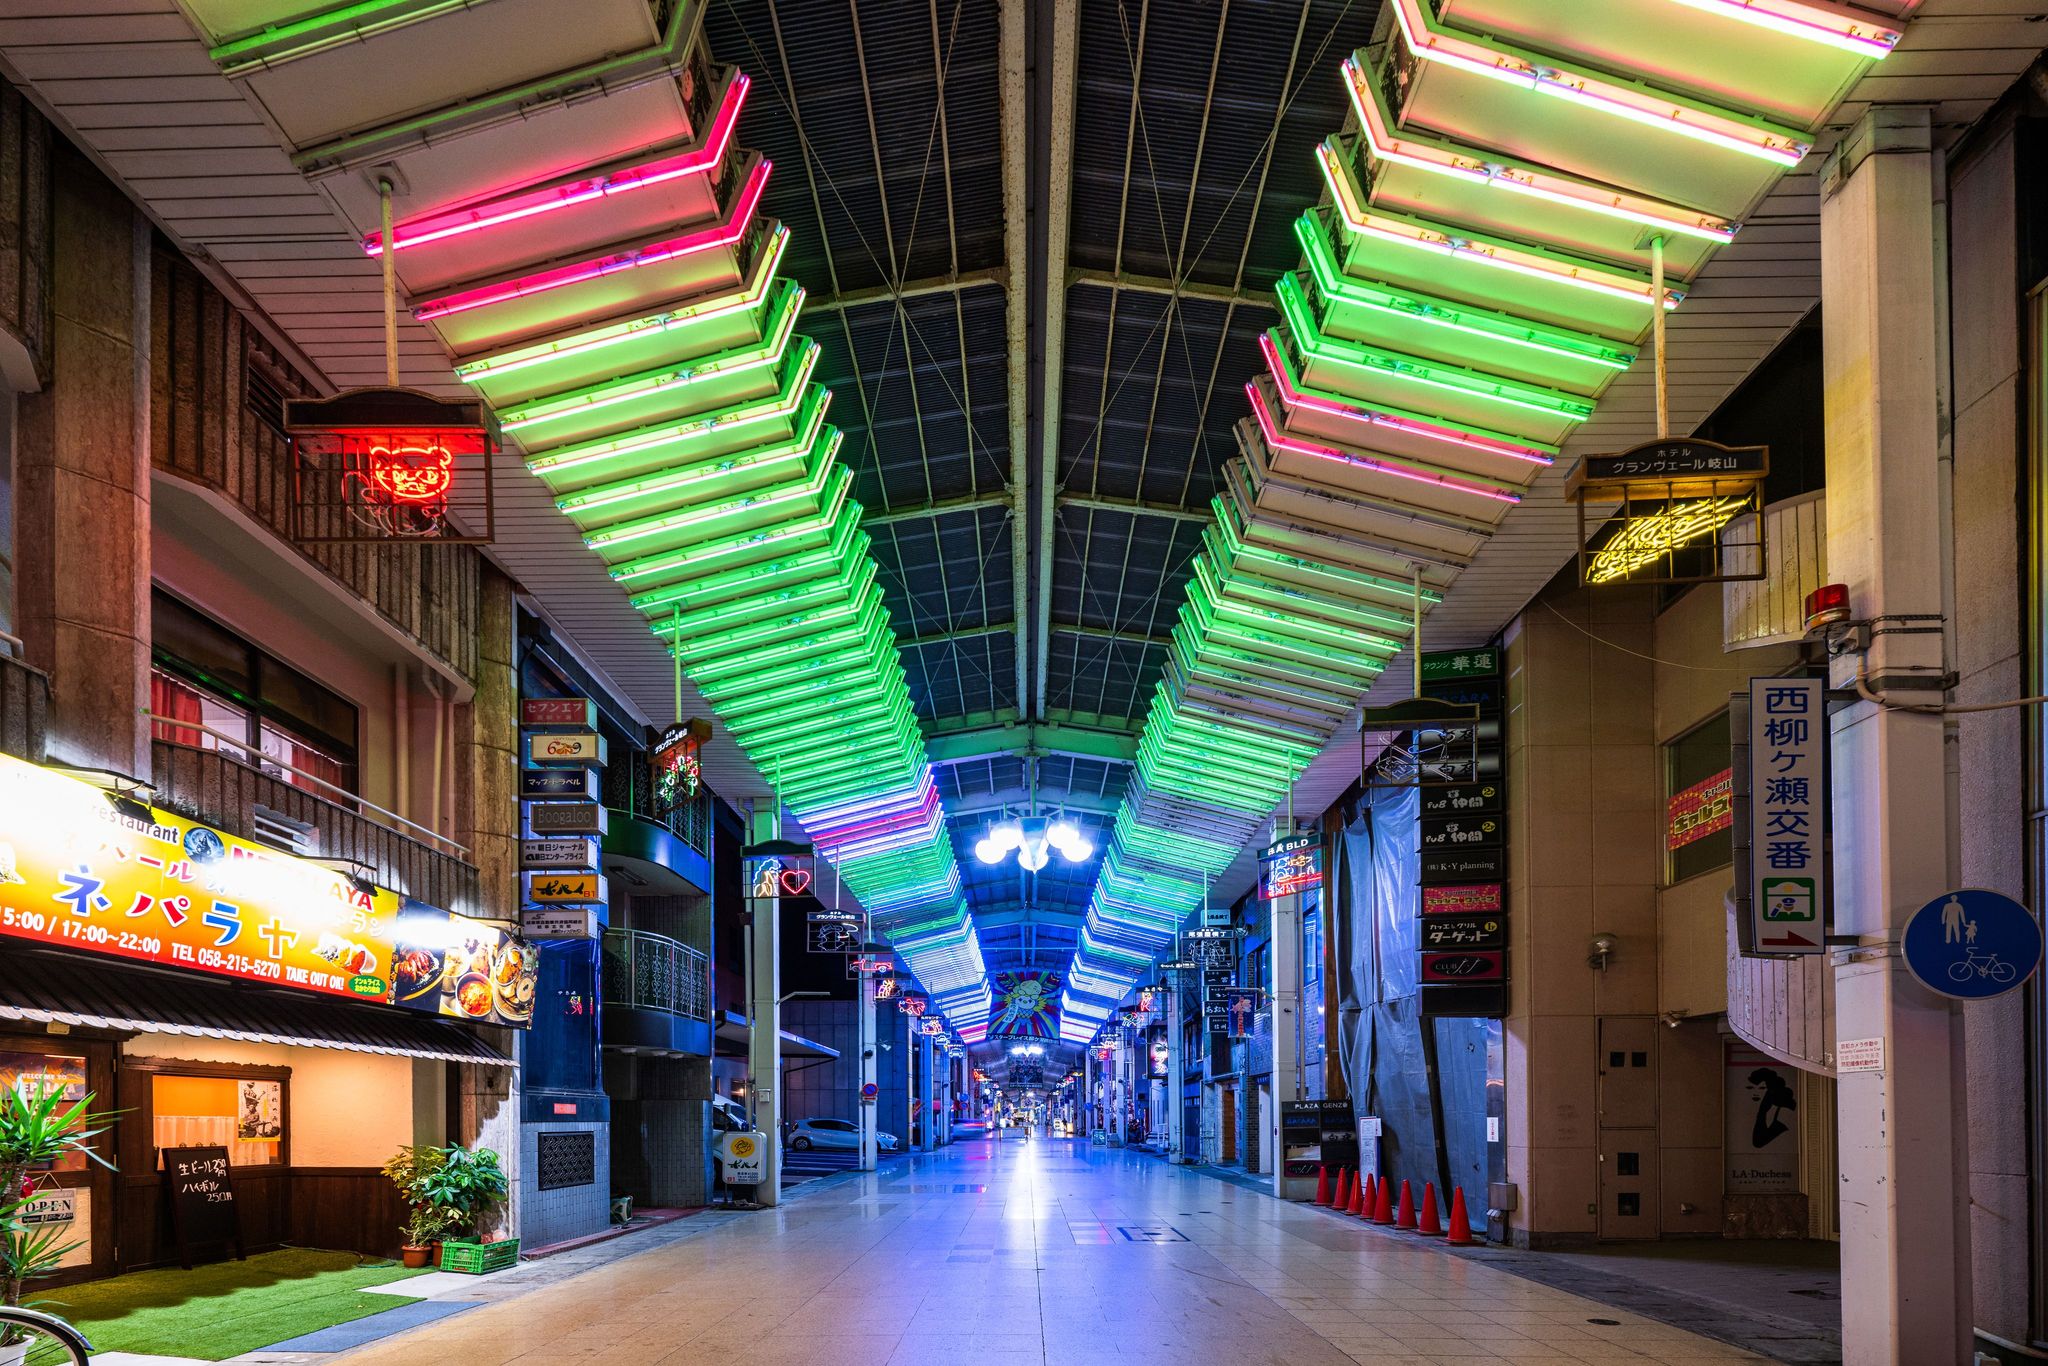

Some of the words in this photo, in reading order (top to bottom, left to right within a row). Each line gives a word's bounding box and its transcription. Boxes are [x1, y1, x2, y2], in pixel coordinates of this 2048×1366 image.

[1657, 448, 1691, 457] ホテル
[1613, 458, 1737, 474] グランヴェール岐山
[1764, 687, 1811, 869] 西柳ケ瀬交番
[1460, 861, 1495, 872] planning
[55, 864, 299, 959] ネパラヤ
[1429, 930, 1490, 943] ターゲット
[0, 908, 45, 931] 5:00
[171, 943, 195, 964] TEL
[198, 949, 281, 979] 058-215-5270
[286, 966, 309, 985] TAKE
[310, 972, 329, 988] OUT
[329, 975, 345, 991] OK!
[179, 1160, 212, 1176] 生ビール
